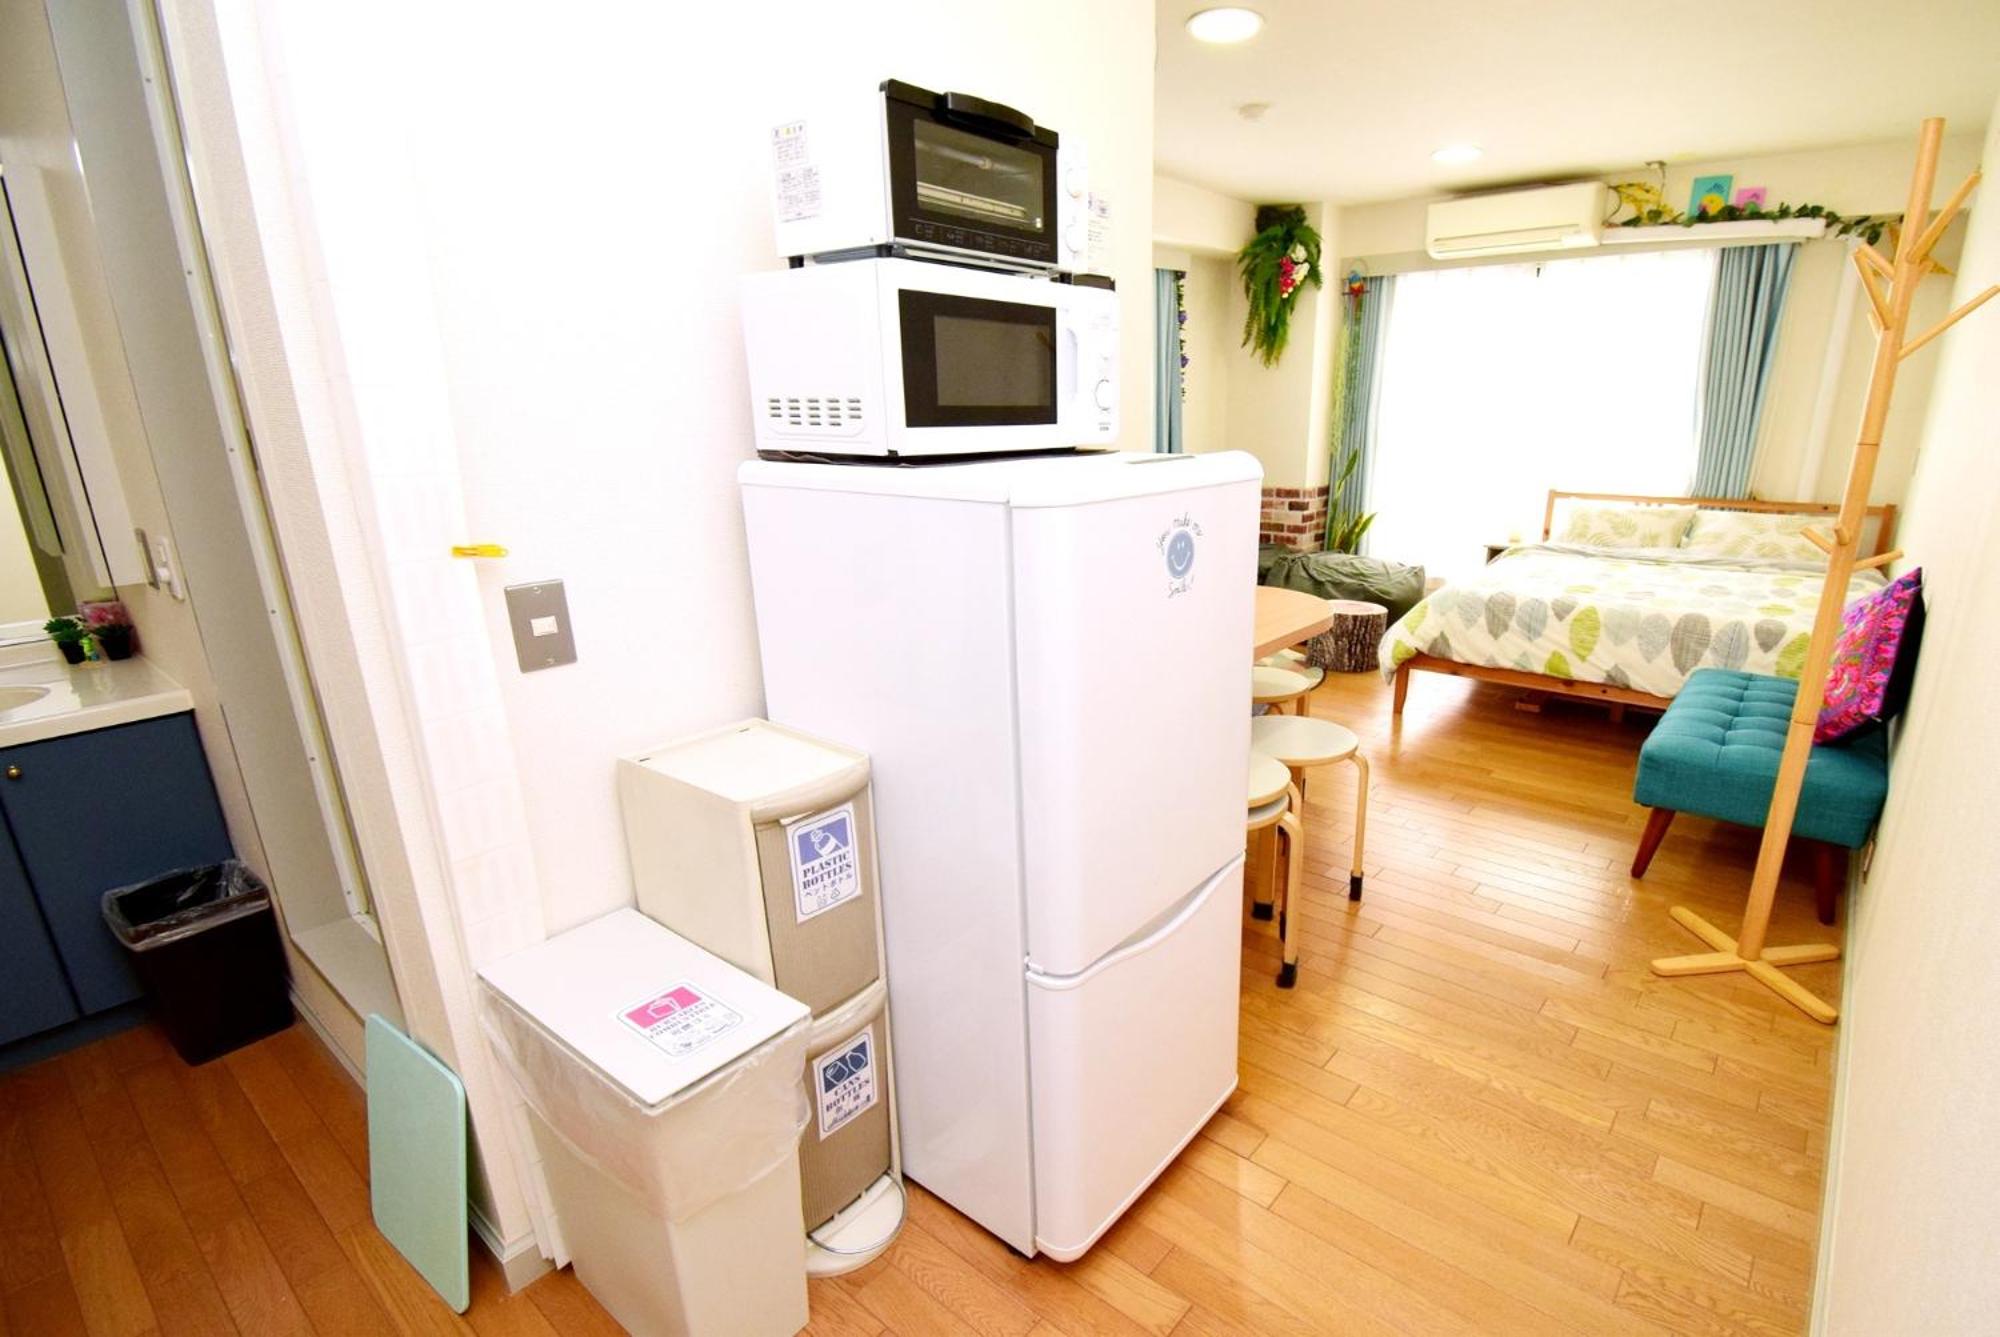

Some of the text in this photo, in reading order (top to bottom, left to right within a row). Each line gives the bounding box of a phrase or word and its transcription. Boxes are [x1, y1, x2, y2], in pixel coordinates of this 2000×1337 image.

[803, 850, 850, 878] PLASTIC
[803, 861, 852, 889] BOTTLES
[826, 1079, 870, 1112] BOTTLES
[834, 1076, 860, 1096] CANS
